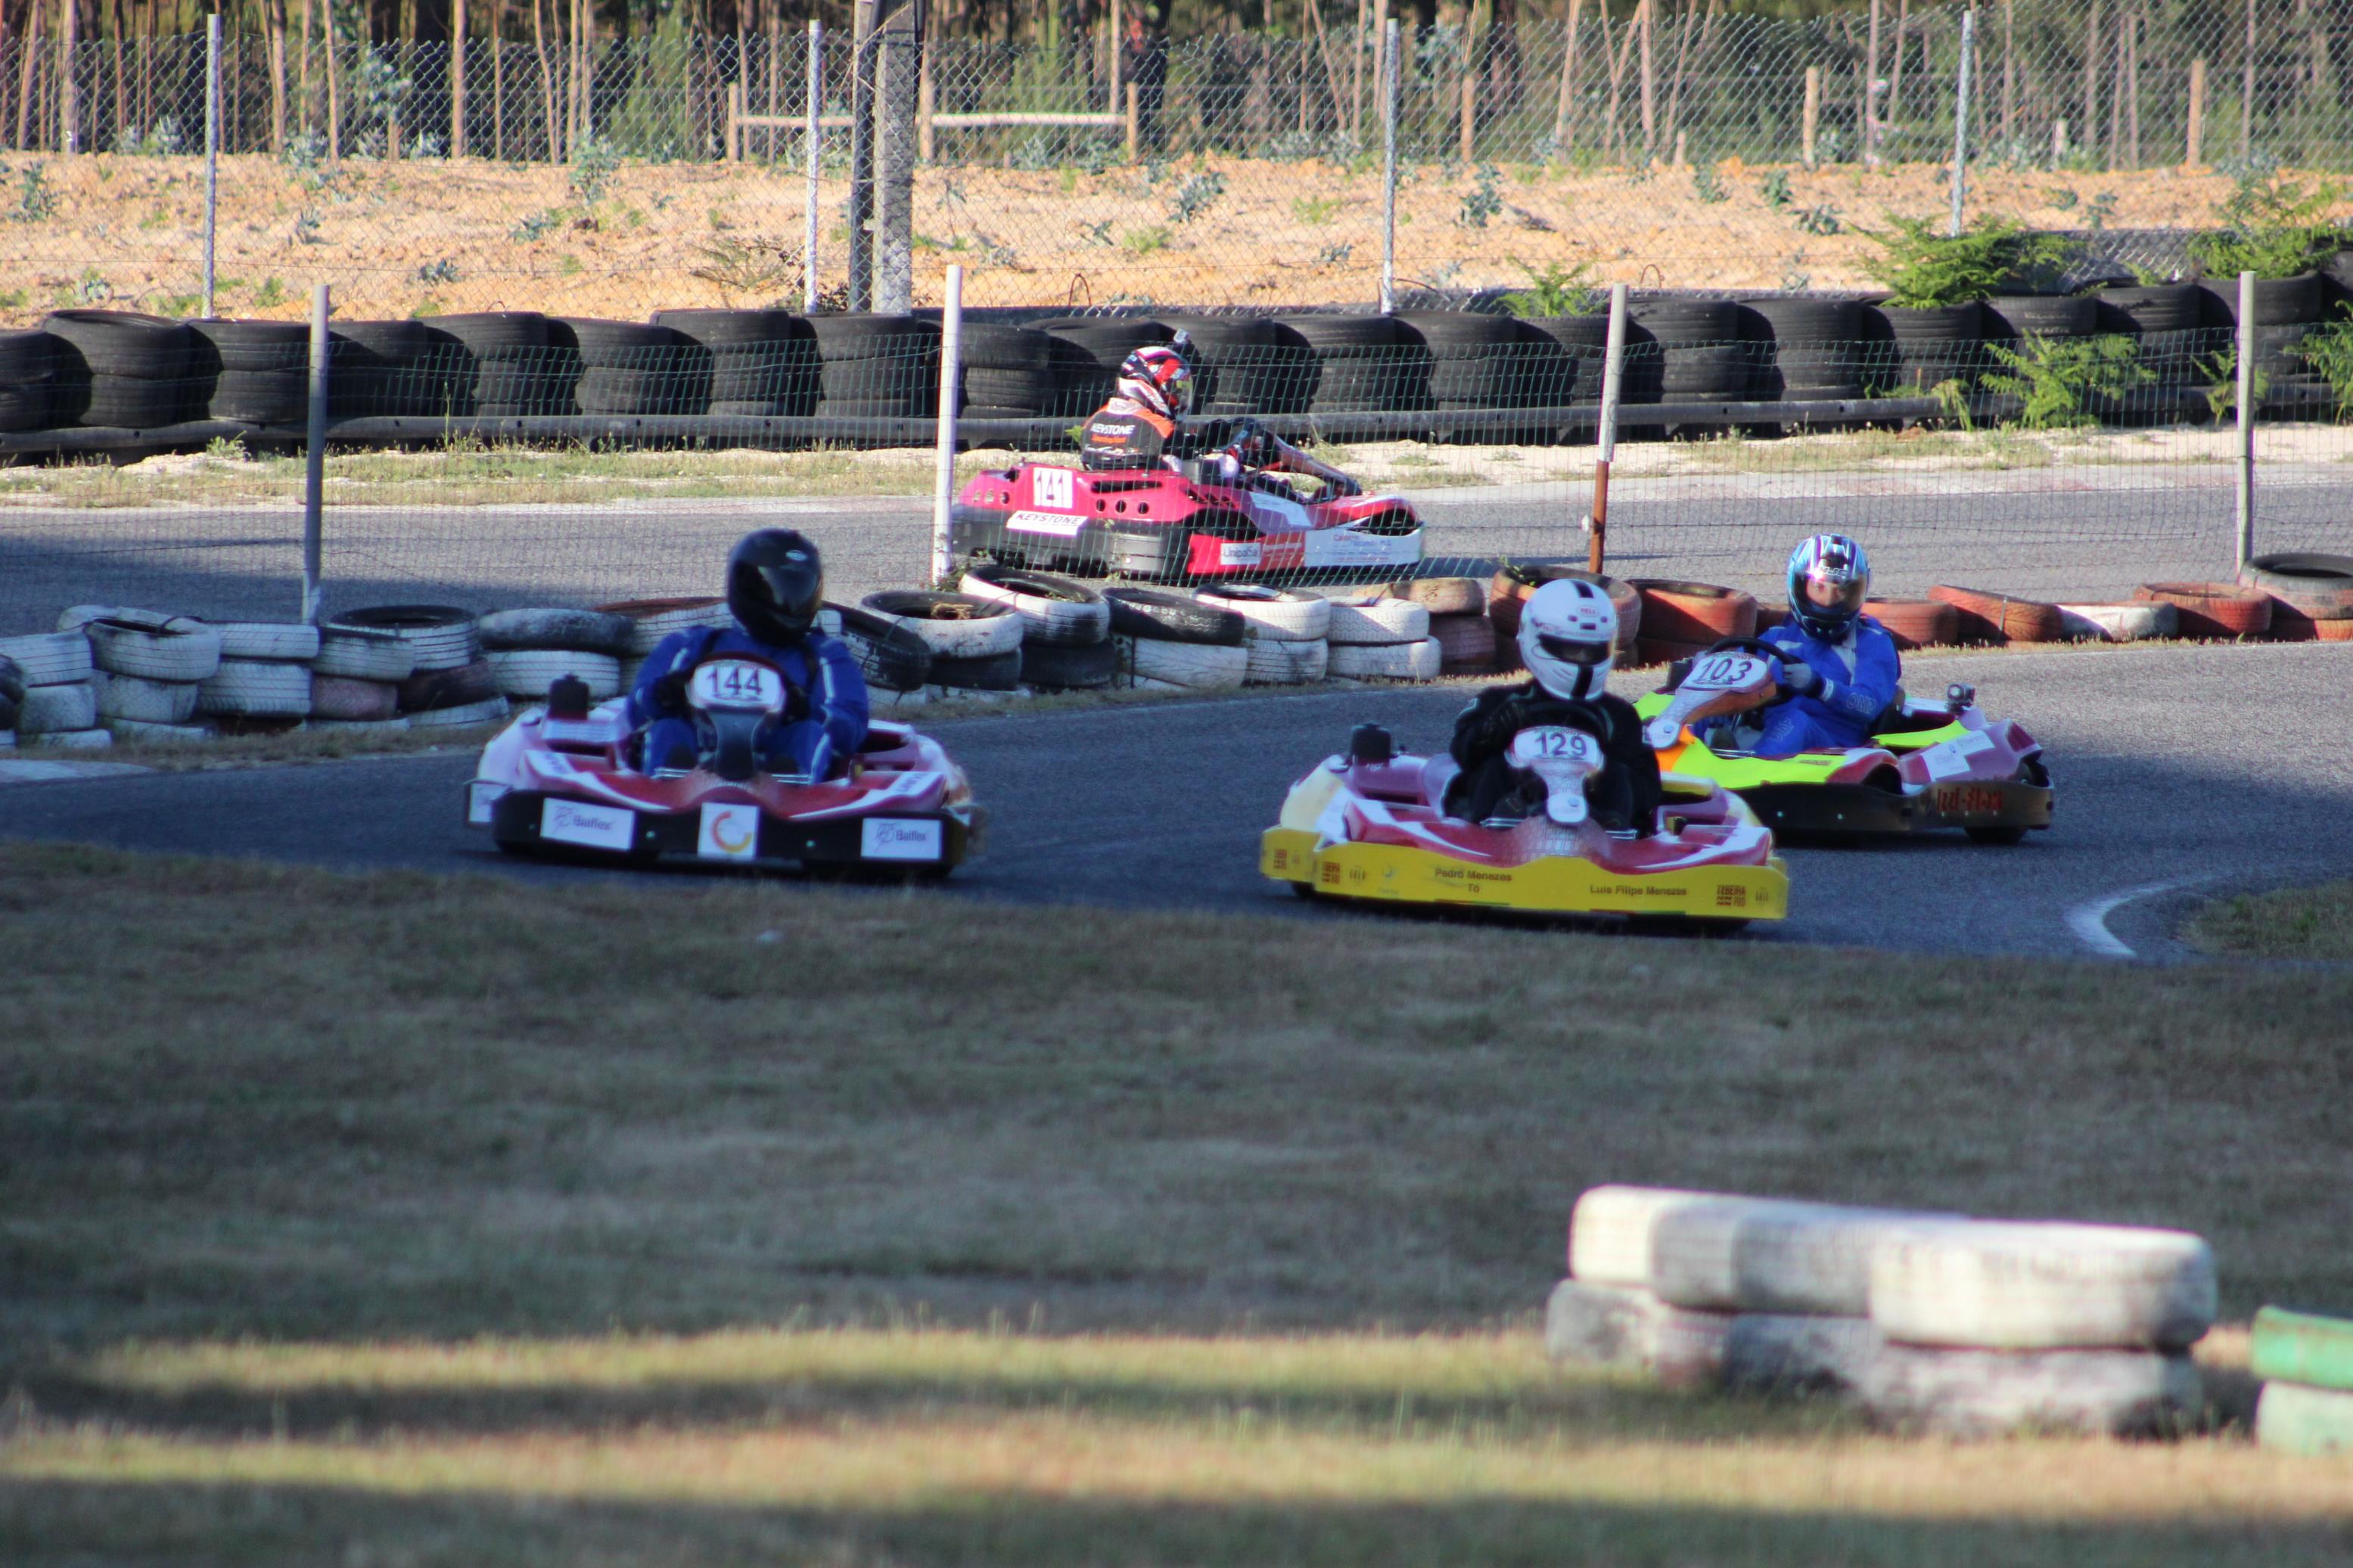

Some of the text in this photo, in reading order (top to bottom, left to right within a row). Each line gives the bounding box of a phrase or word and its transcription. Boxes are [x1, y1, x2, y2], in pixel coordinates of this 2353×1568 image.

[1090, 423, 1136, 435] KEYSTONE
[1037, 470, 1065, 507] 141
[1015, 513, 1082, 525] KEYSTONE
[1699, 657, 1753, 682] 103
[707, 666, 763, 696] 144
[1535, 731, 1587, 757] 129
[1435, 868, 1512, 882] Pedro Menezes
[1616, 885, 1643, 896] Filipe
[1646, 886, 1687, 896] Menezes
